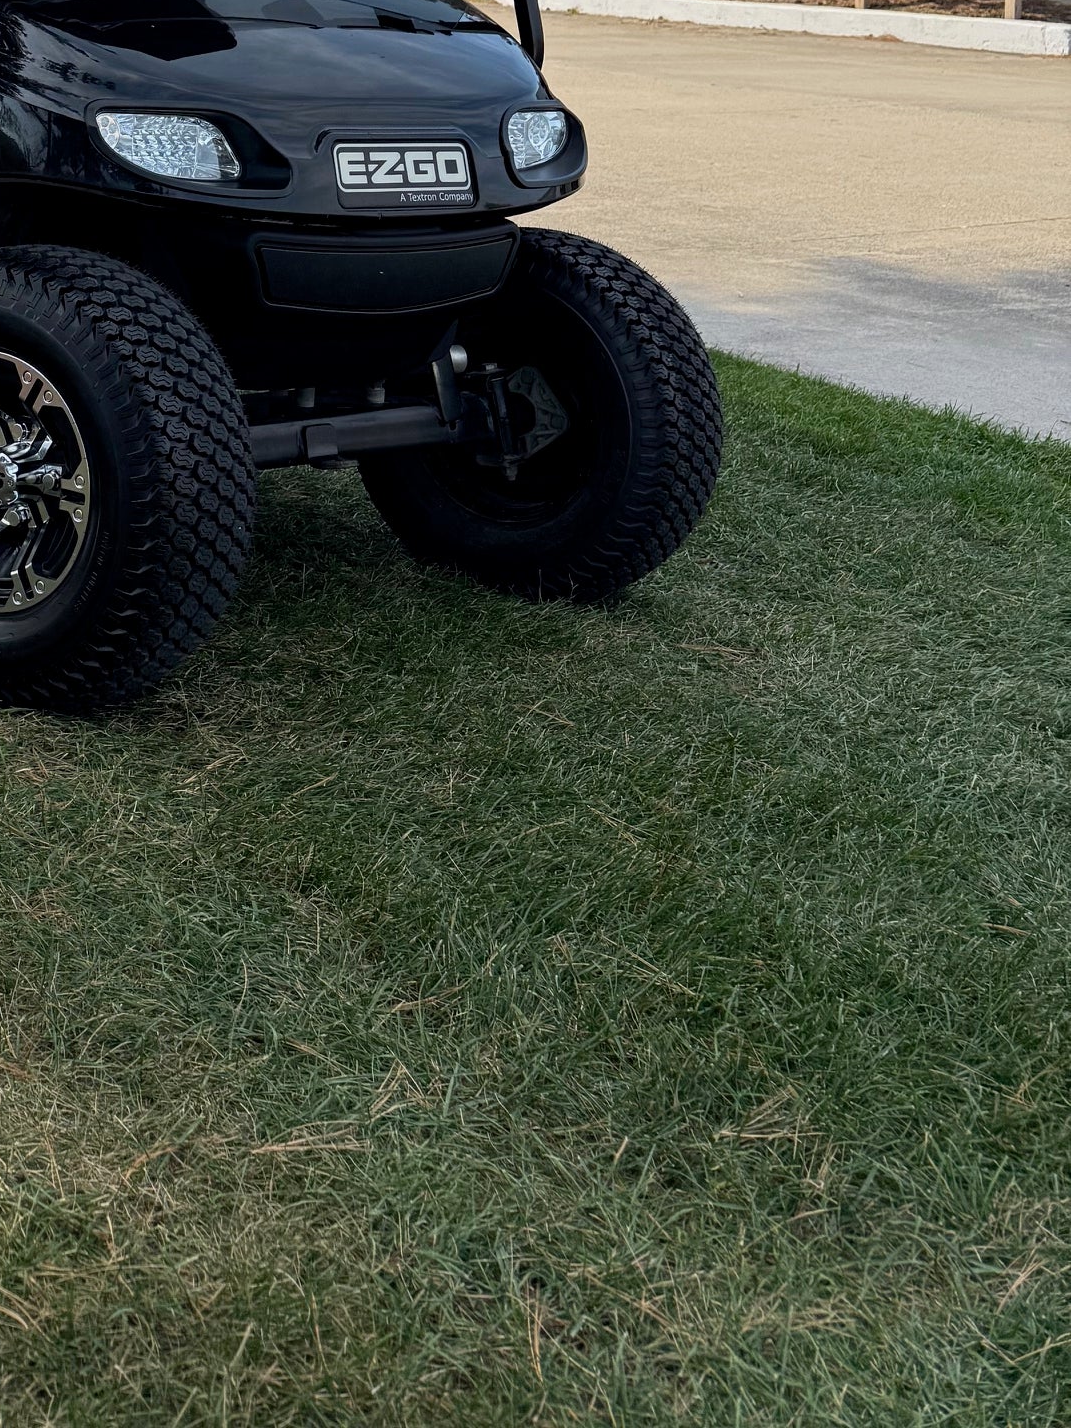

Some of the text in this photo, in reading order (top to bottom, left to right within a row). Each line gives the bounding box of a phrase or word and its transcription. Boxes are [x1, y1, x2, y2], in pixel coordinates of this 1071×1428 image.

[400, 192, 474, 203] A Textron Company
